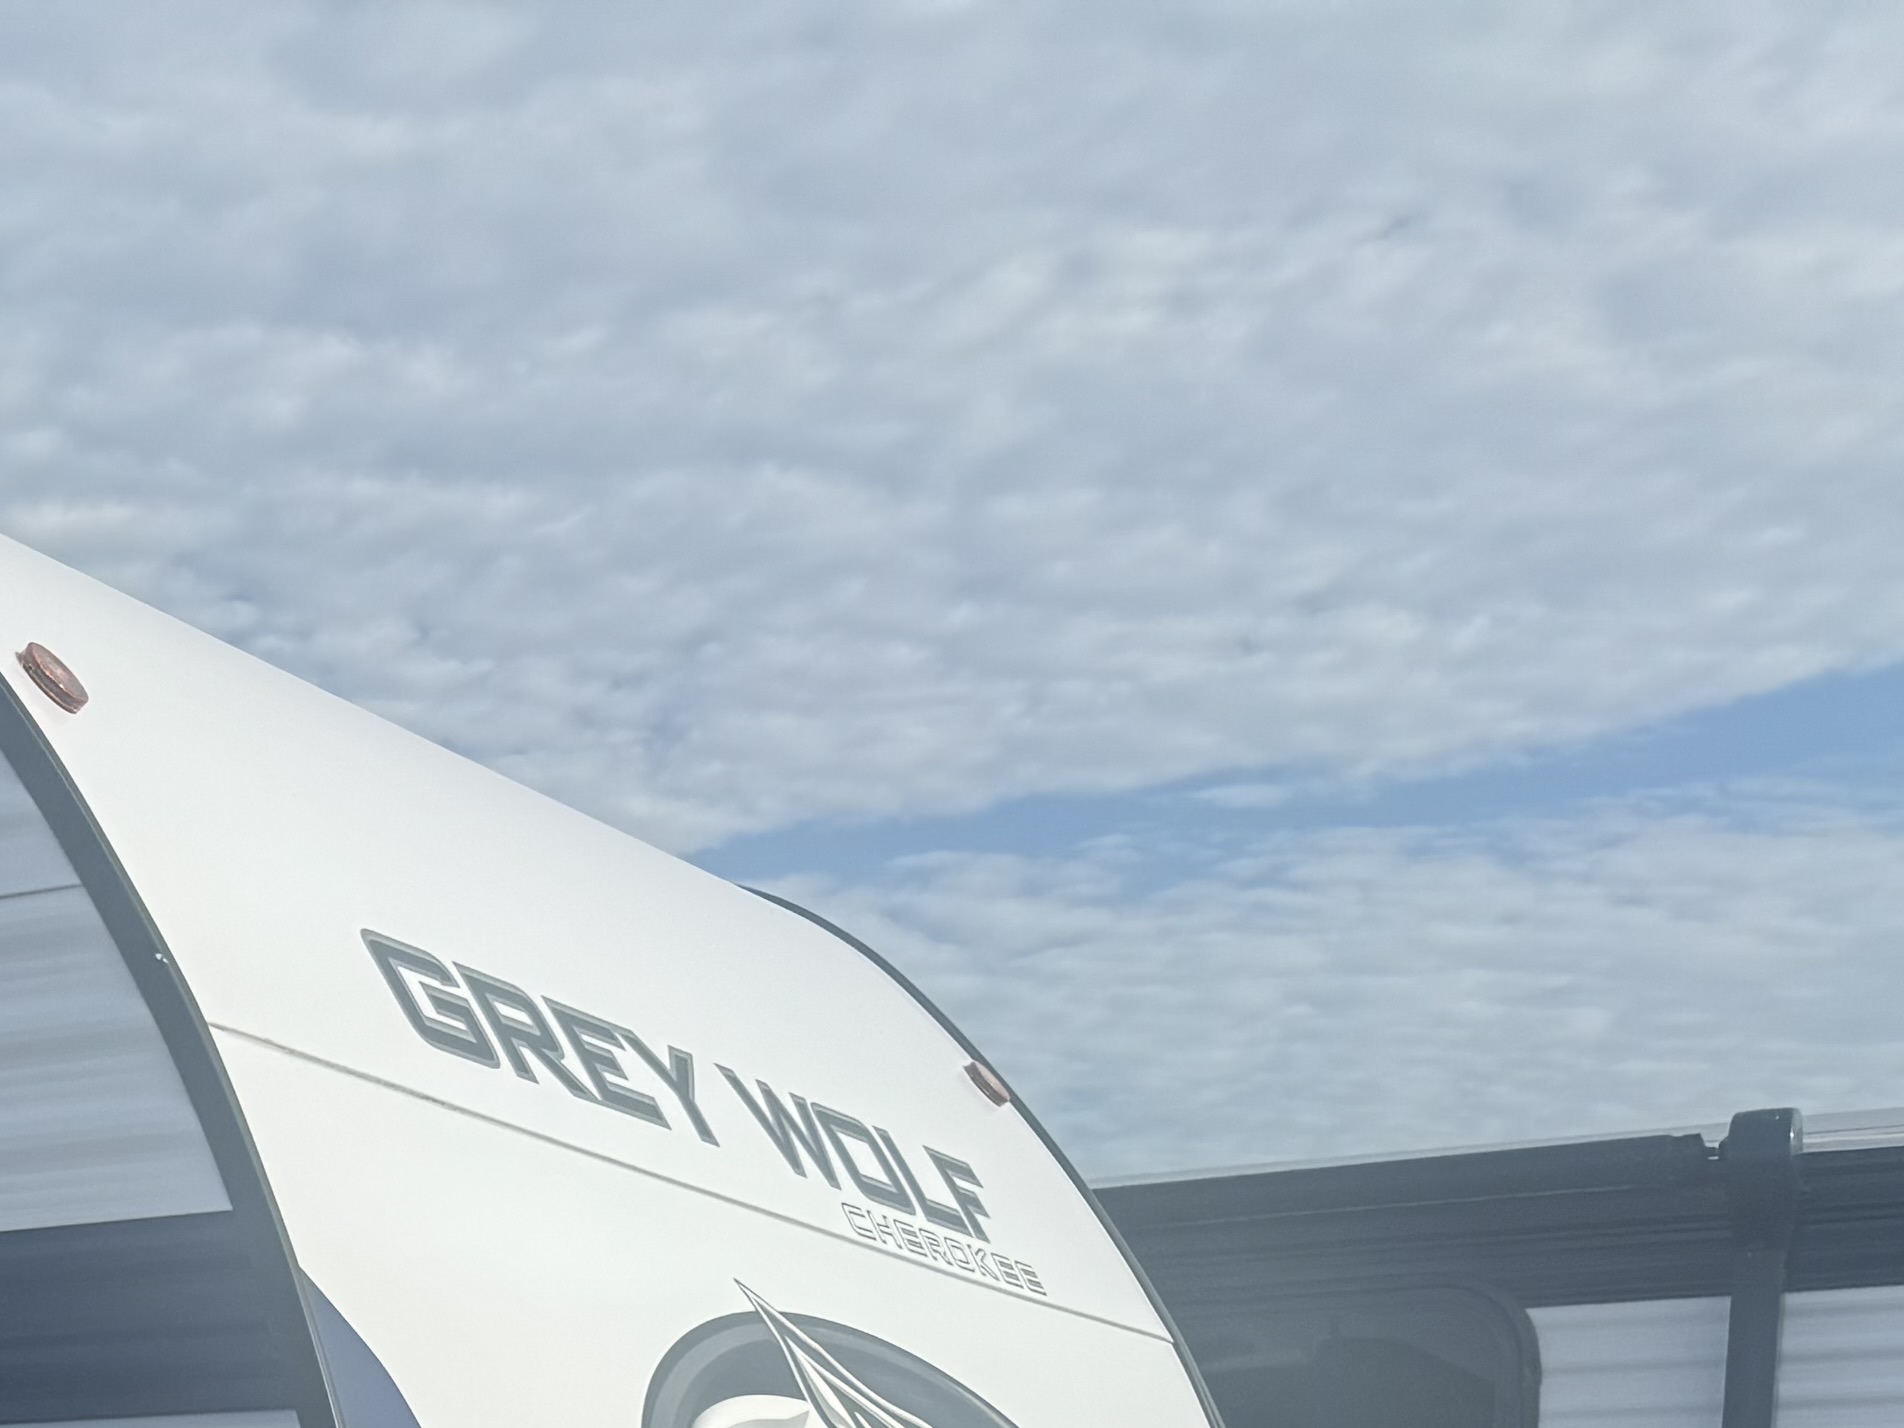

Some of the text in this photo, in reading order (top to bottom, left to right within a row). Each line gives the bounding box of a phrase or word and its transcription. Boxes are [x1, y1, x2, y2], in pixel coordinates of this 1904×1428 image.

[359, 927, 992, 1245] GREY WOLF
[841, 1201, 1048, 1297] CHEROKEE
